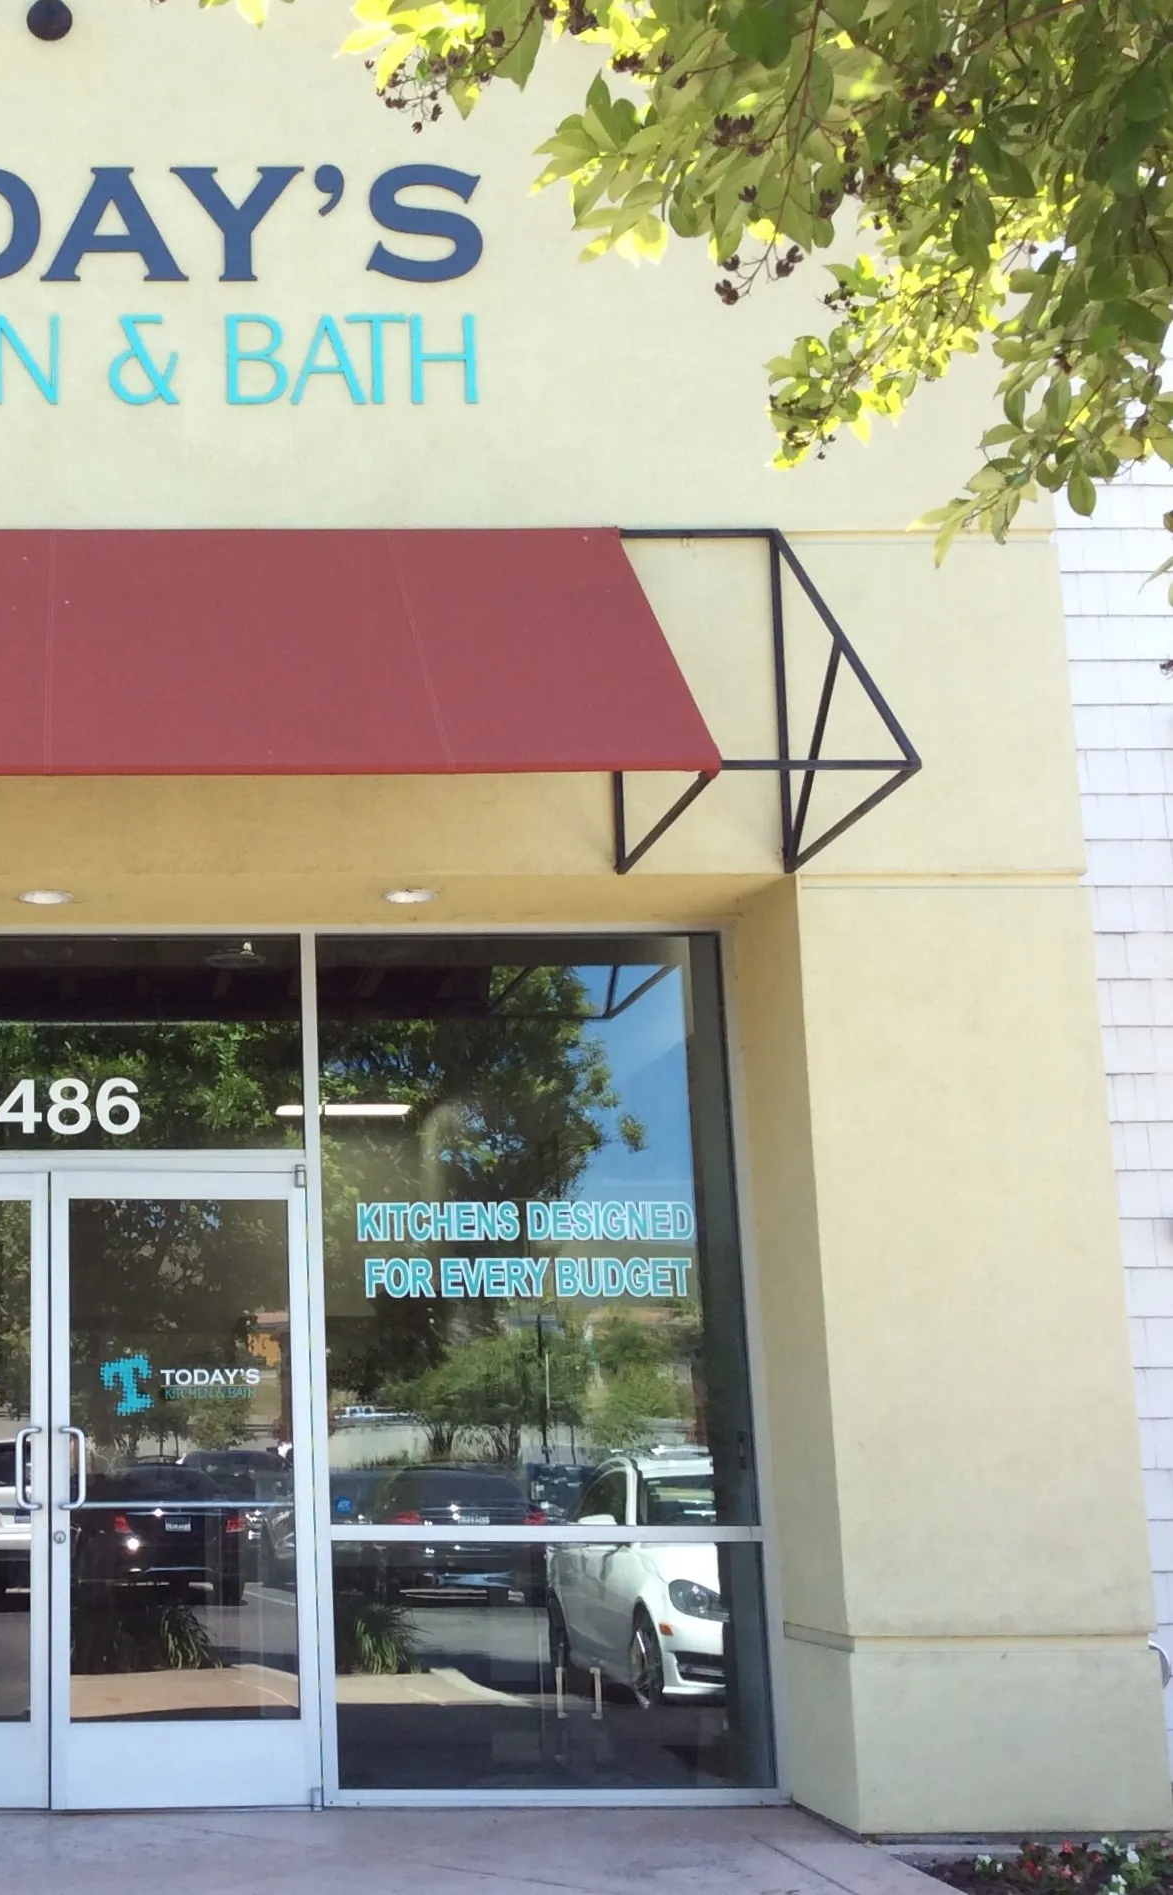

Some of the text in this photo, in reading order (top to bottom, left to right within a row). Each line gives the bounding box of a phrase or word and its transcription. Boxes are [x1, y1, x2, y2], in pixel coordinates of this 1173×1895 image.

[109, 314, 180, 406] &
[227, 313, 478, 405] BATH
[356, 1200, 695, 1243] KITCHENS DESIGNED
[364, 1257, 692, 1299] FOR EVERY BUDGET
[160, 1368, 261, 1386] TODAY'S
